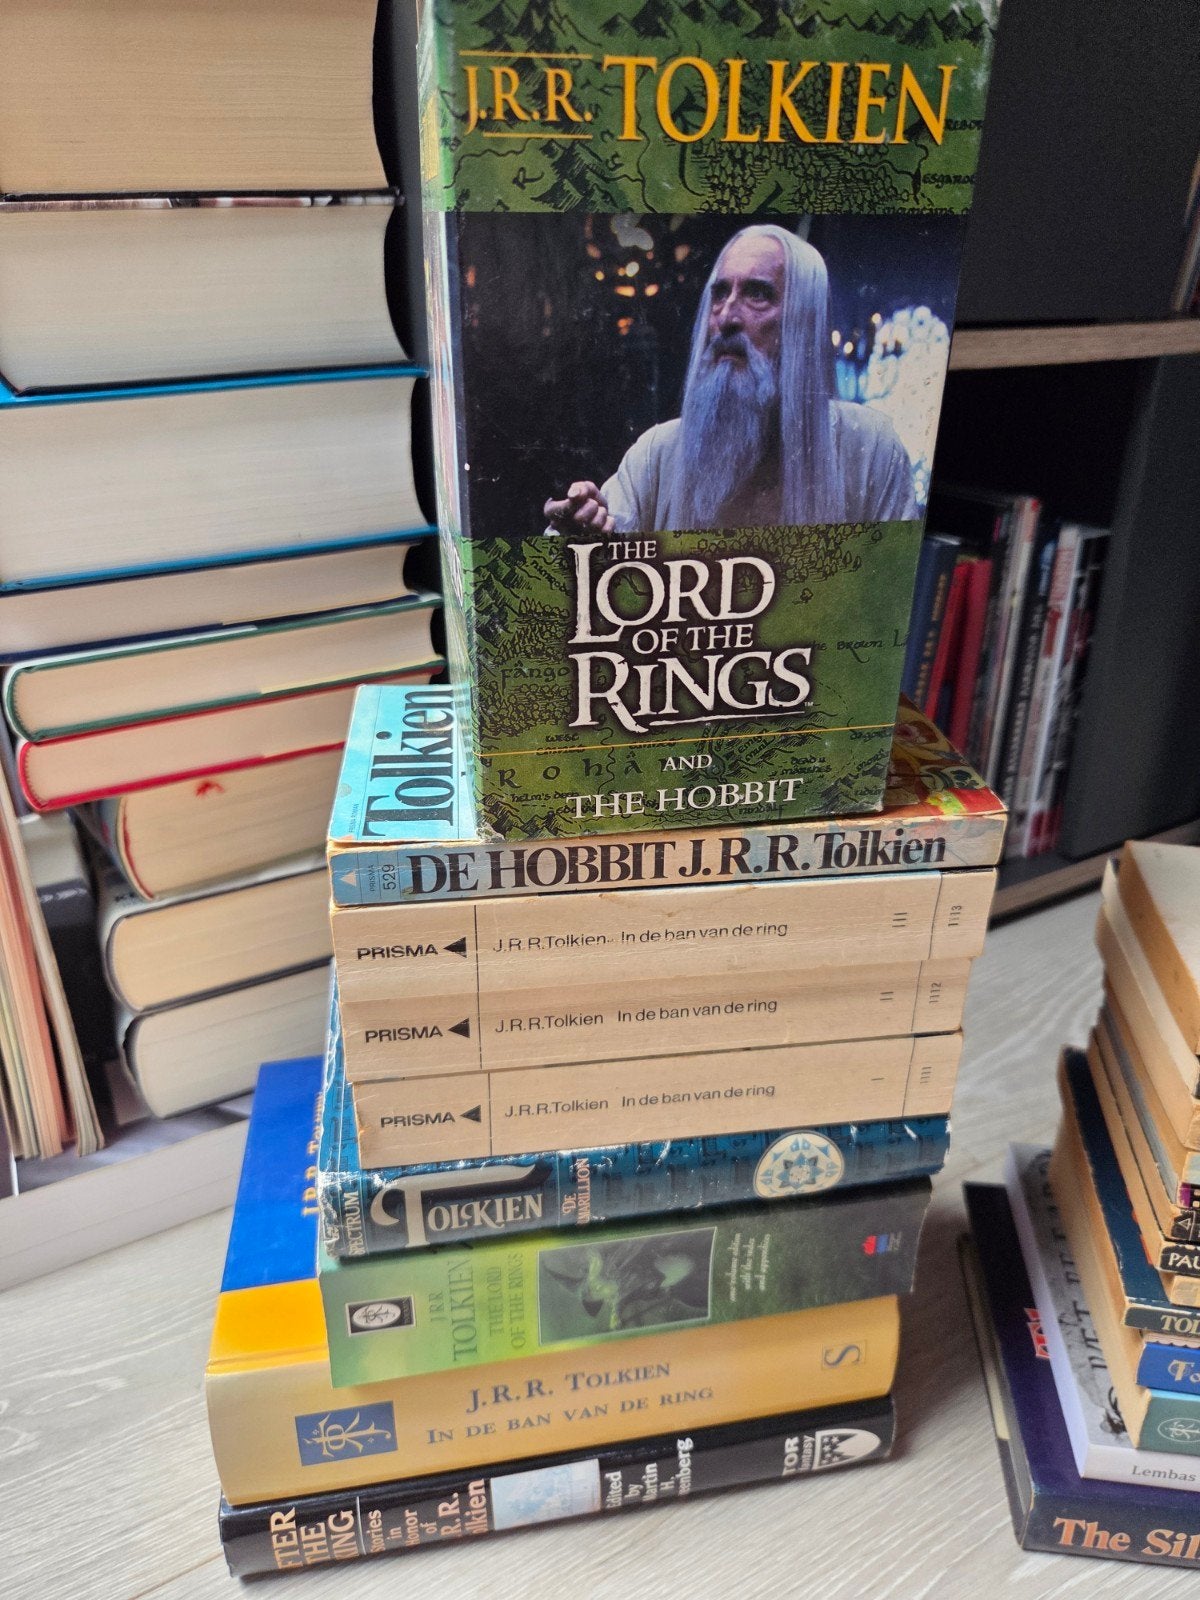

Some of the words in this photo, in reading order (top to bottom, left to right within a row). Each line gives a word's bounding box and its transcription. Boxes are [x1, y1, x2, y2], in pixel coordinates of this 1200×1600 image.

[603, 56, 957, 145] TOLKIEN
[608, 541, 657, 560] THE
[567, 543, 776, 644] LORD
[632, 627, 679, 654] OF
[686, 624, 754, 651] THE
[568, 647, 812, 734] RINGS
[362, 690, 456, 838] Tolkien
[662, 754, 713, 772] AND
[566, 791, 645, 819] THE
[656, 778, 804, 812] HOBBIT
[367, 864, 376, 892] PRISMA
[382, 864, 397, 891] 529
[406, 852, 479, 895] DE
[486, 841, 675, 889] HOBBIT
[814, 828, 946, 870] Tolkien
[357, 943, 438, 960] PRISMA
[756, 922, 788, 937] ring
[365, 1025, 443, 1043] PRISMA
[747, 999, 778, 1013] ring
[380, 1111, 456, 1128] PRISMA
[746, 1084, 776, 1098] ring
[370, 1163, 545, 1249] TOLKIEN
[561, 1193, 578, 1215] DE
[344, 1190, 365, 1257] SPECTRUM
[486, 1266, 503, 1302] LORD
[507, 1252, 524, 1289] RINGS
[447, 1257, 478, 1362] TOLKIEN
[487, 1304, 504, 1337] THE
[508, 1291, 525, 1324] THE
[510, 1326, 526, 1349] OF
[565, 1362, 671, 1392] TOLKIEN
[426, 1428, 454, 1445] IN
[466, 1421, 495, 1438] DE
[507, 1413, 552, 1430] BAN
[563, 1403, 608, 1422] VAN
[620, 1399, 648, 1413] DE
[659, 1386, 714, 1407] RING
[605, 1470, 623, 1509] Edited
[625, 1482, 644, 1499] by
[642, 1462, 658, 1502] Martin
[659, 1475, 676, 1493] H.
[1132, 1465, 1196, 1483] Lembas
[301, 1521, 332, 1565] THE
[366, 1509, 386, 1554] Stories
[386, 1526, 402, 1541] in
[404, 1509, 420, 1548] Honor
[419, 1520, 438, 1535] of
[1053, 1517, 1131, 1552] The
